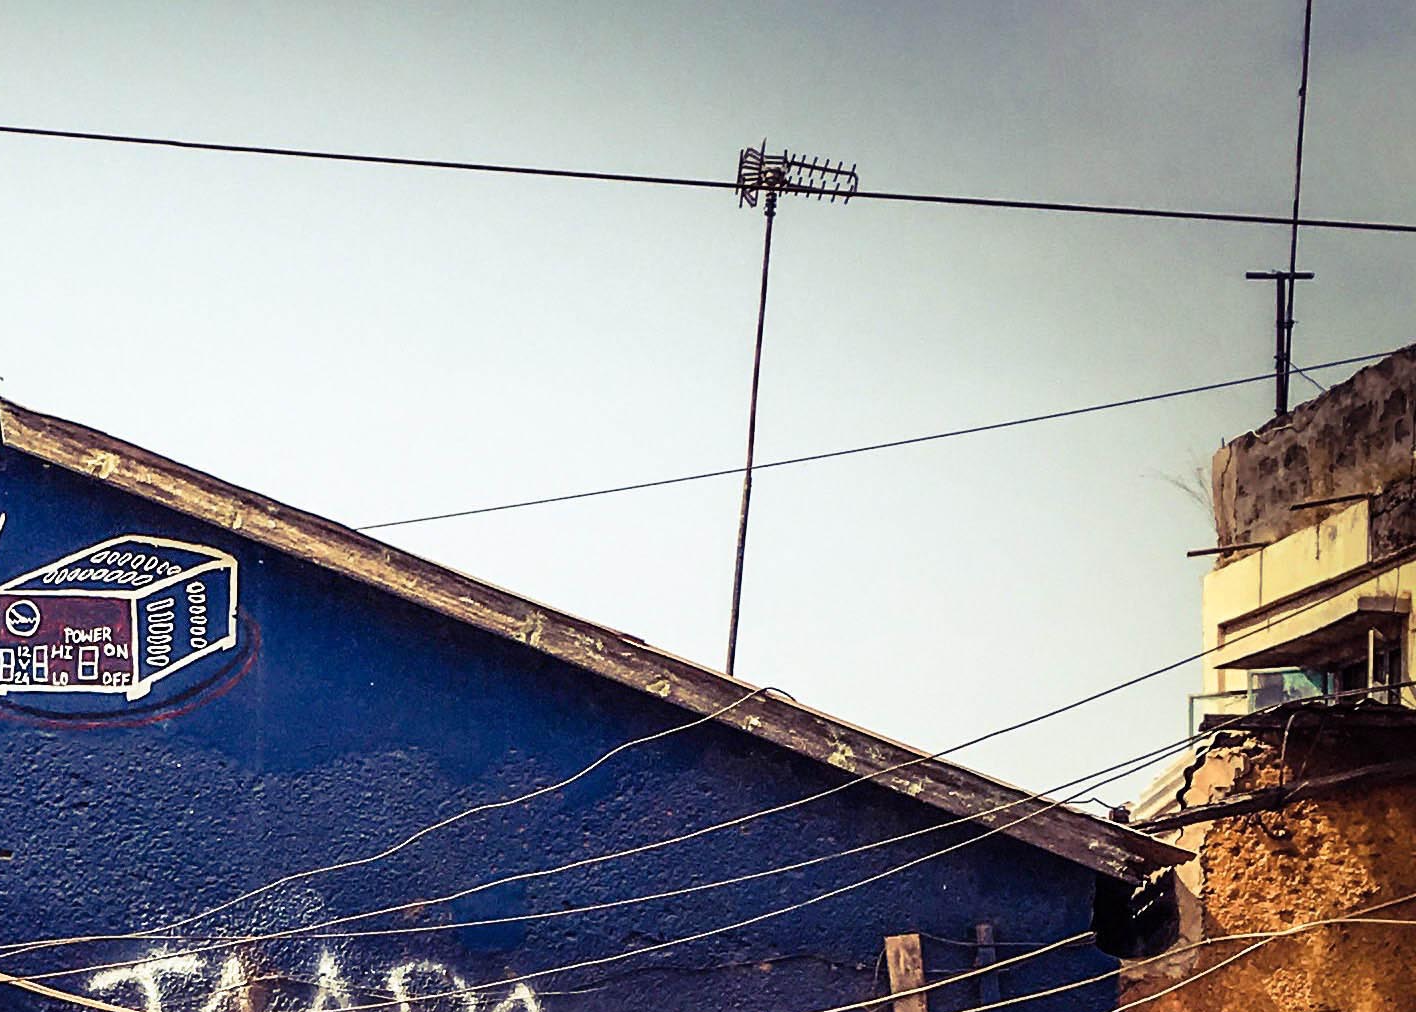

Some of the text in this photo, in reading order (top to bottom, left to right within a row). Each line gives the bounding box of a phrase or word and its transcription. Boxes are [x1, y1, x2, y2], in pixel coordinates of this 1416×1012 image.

[64, 627, 112, 643] POWER
[17, 646, 31, 658] 12
[51, 645, 73, 660] HI
[104, 643, 129, 660] ON
[14, 671, 30, 685] 24
[52, 671, 69, 686] LO
[102, 671, 131, 686] OFF
